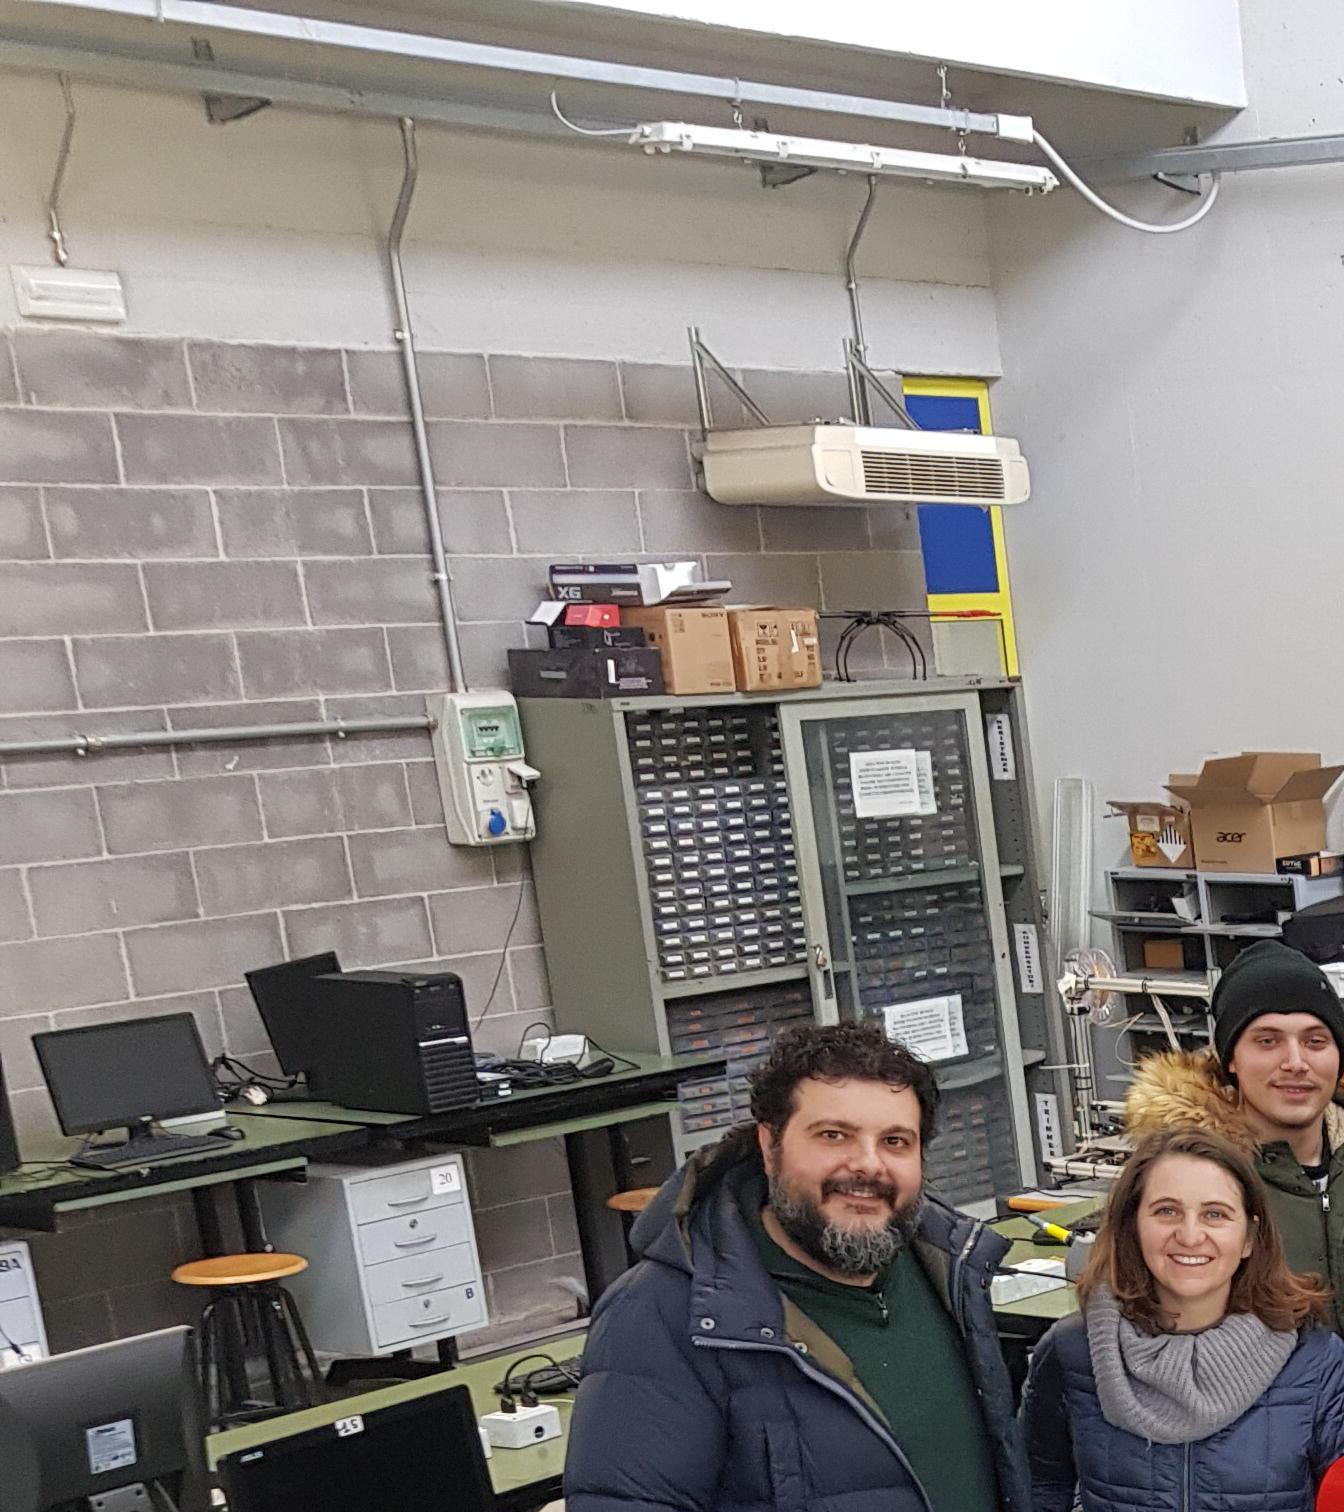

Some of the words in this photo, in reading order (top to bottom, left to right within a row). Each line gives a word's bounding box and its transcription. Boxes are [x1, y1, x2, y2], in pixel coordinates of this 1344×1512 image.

[1216, 832, 1247, 843] acer
[438, 1172, 453, 1186] 20
[465, 1288, 475, 1300] B
